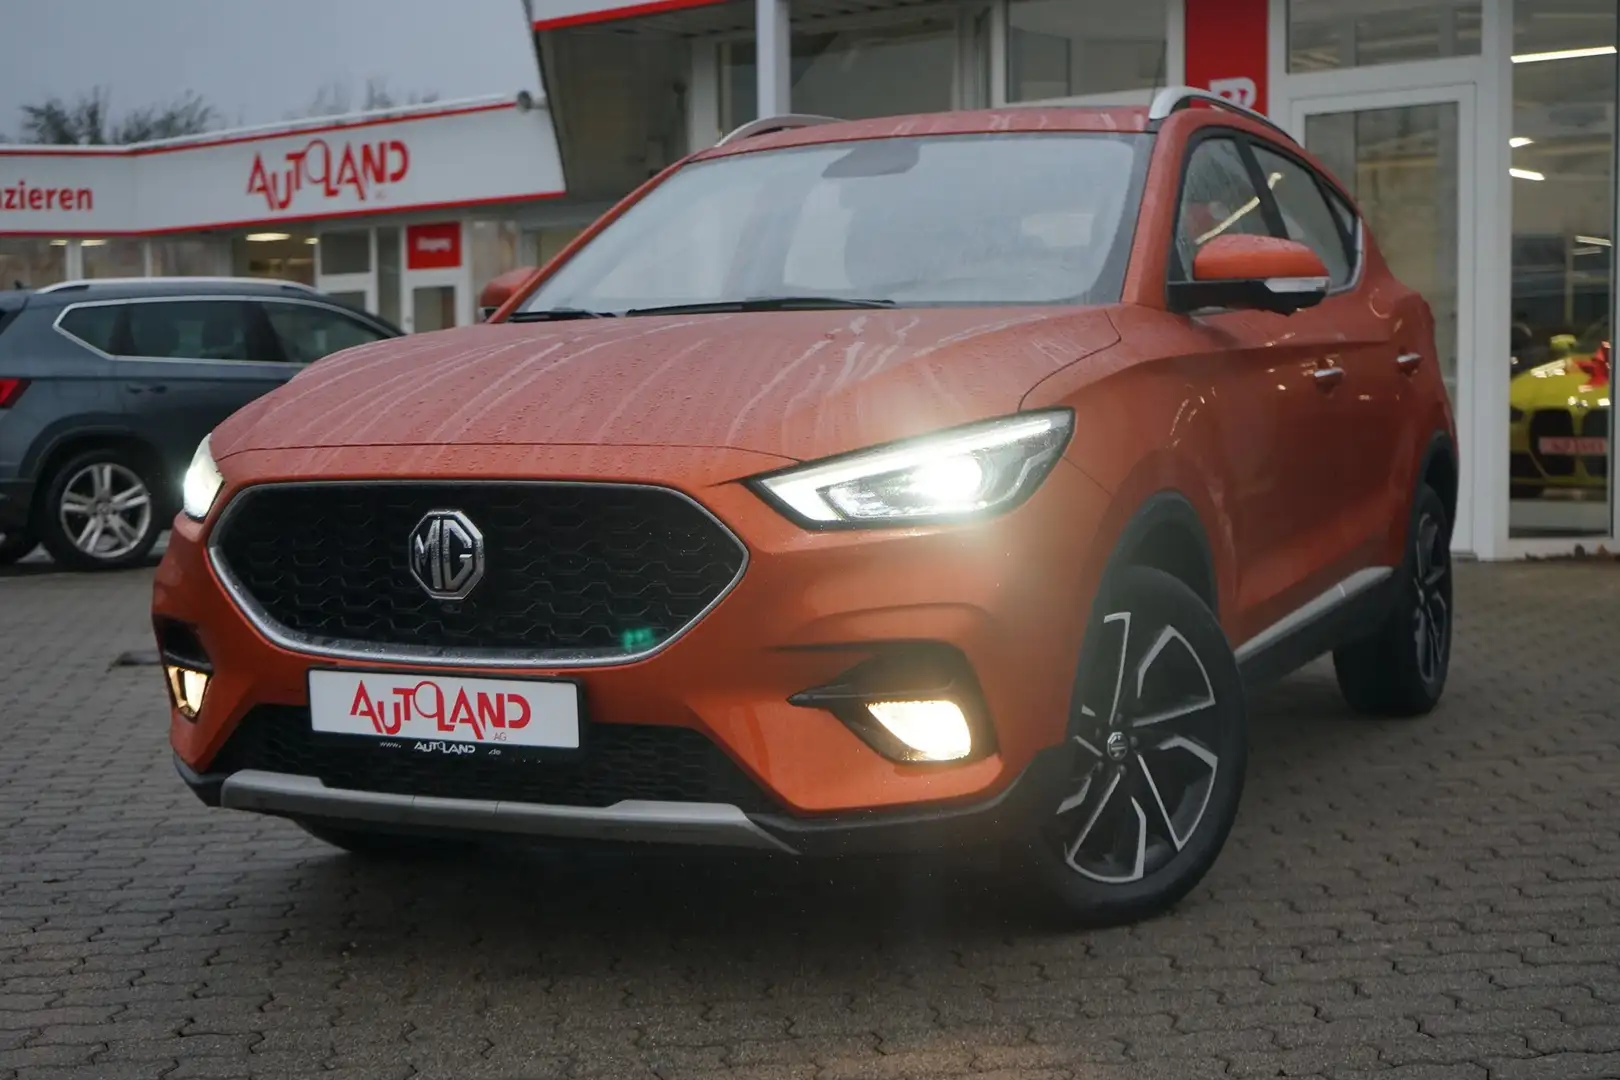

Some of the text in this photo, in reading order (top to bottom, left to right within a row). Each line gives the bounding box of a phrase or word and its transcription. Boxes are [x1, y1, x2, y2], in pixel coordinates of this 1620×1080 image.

[248, 139, 409, 210] AUTOLAND
[415, 519, 472, 590] MG
[350, 680, 531, 740] AUTOLAND
[493, 732, 507, 741] AG
[414, 740, 476, 755] AUTOLAND
